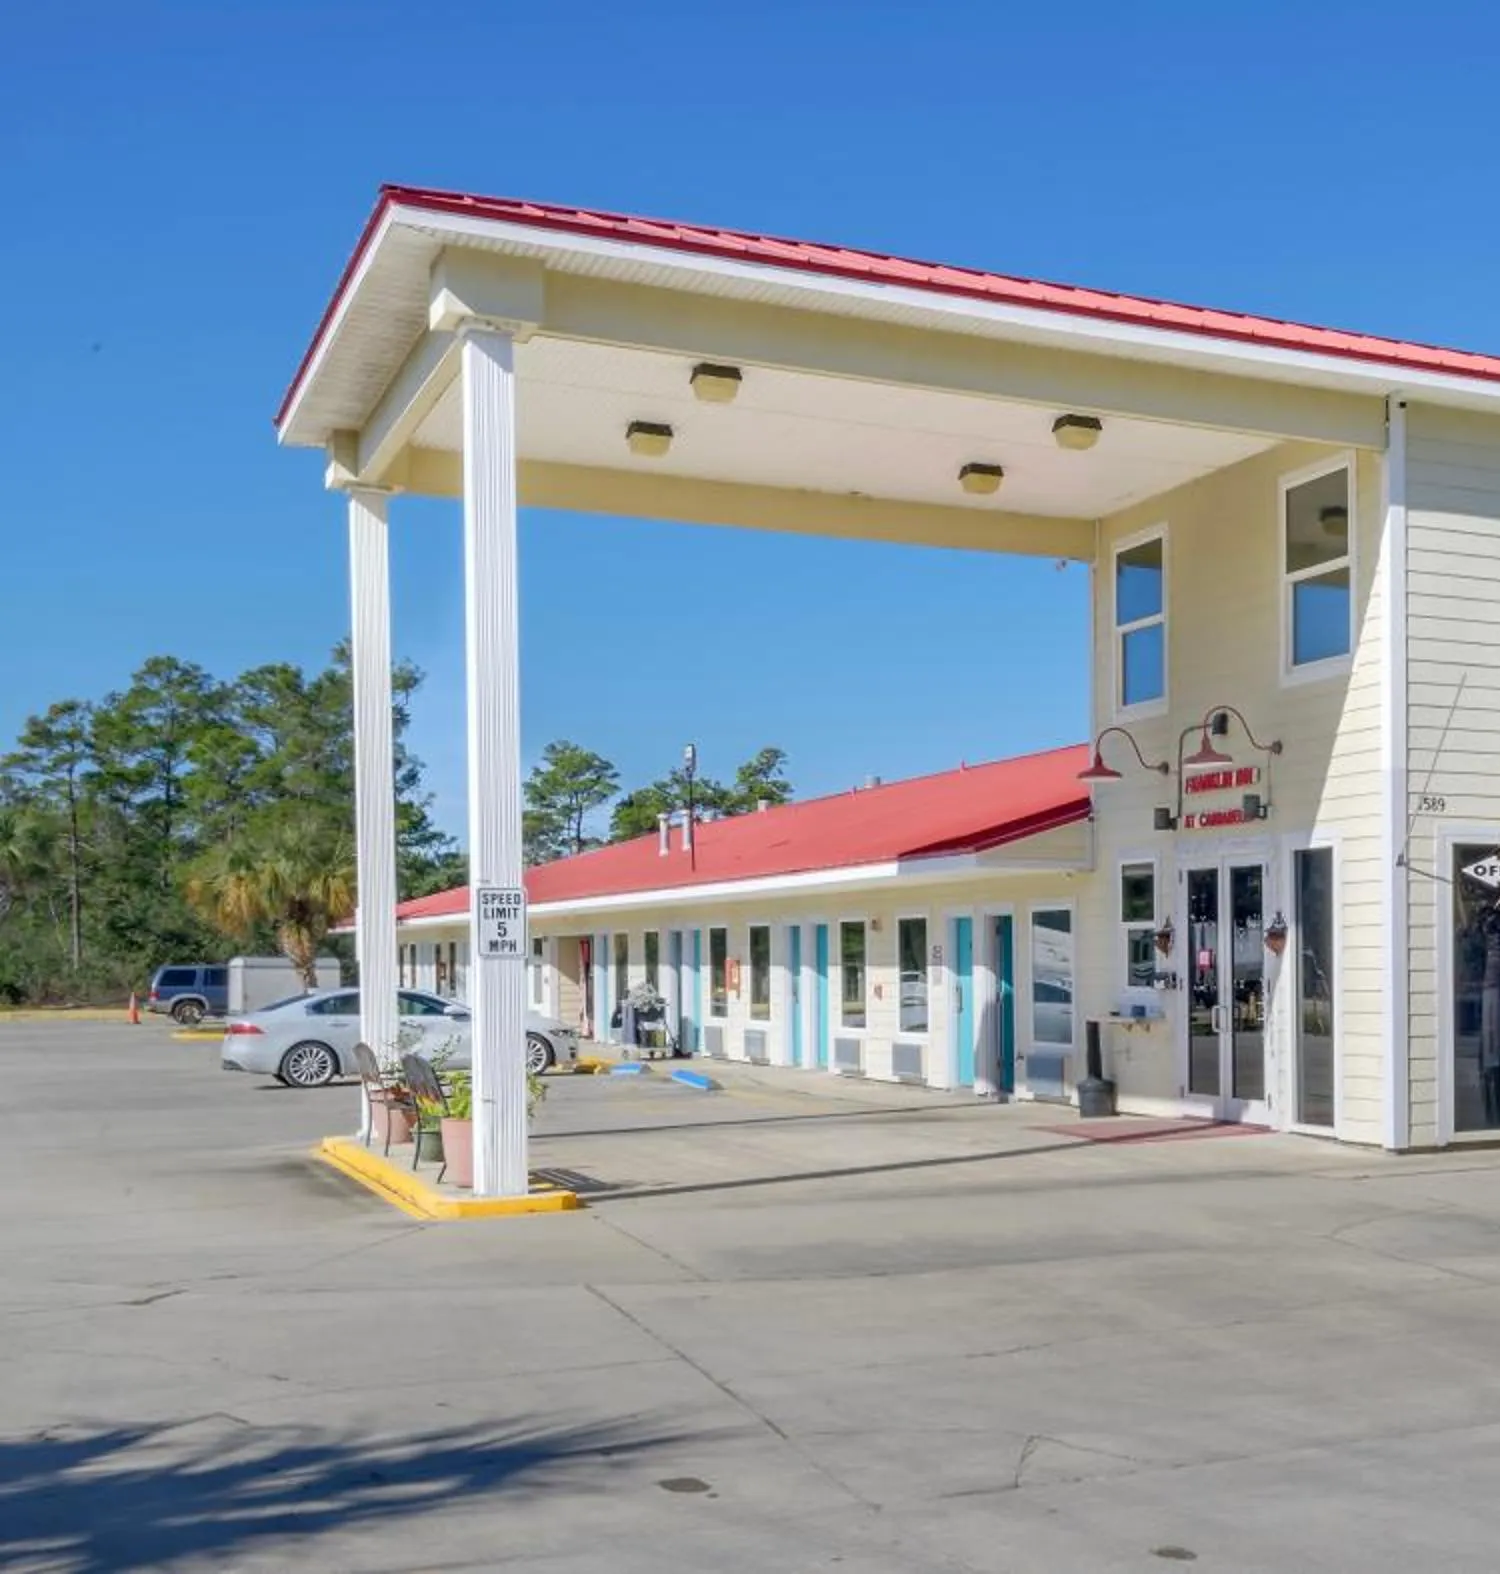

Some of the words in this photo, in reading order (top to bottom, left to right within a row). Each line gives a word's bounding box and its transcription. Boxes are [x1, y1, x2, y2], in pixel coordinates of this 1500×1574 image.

[482, 893, 521, 905] SPEED
[483, 907, 520, 919] LIMIT
[497, 921, 507, 938] 5
[489, 939, 517, 952] MPH
